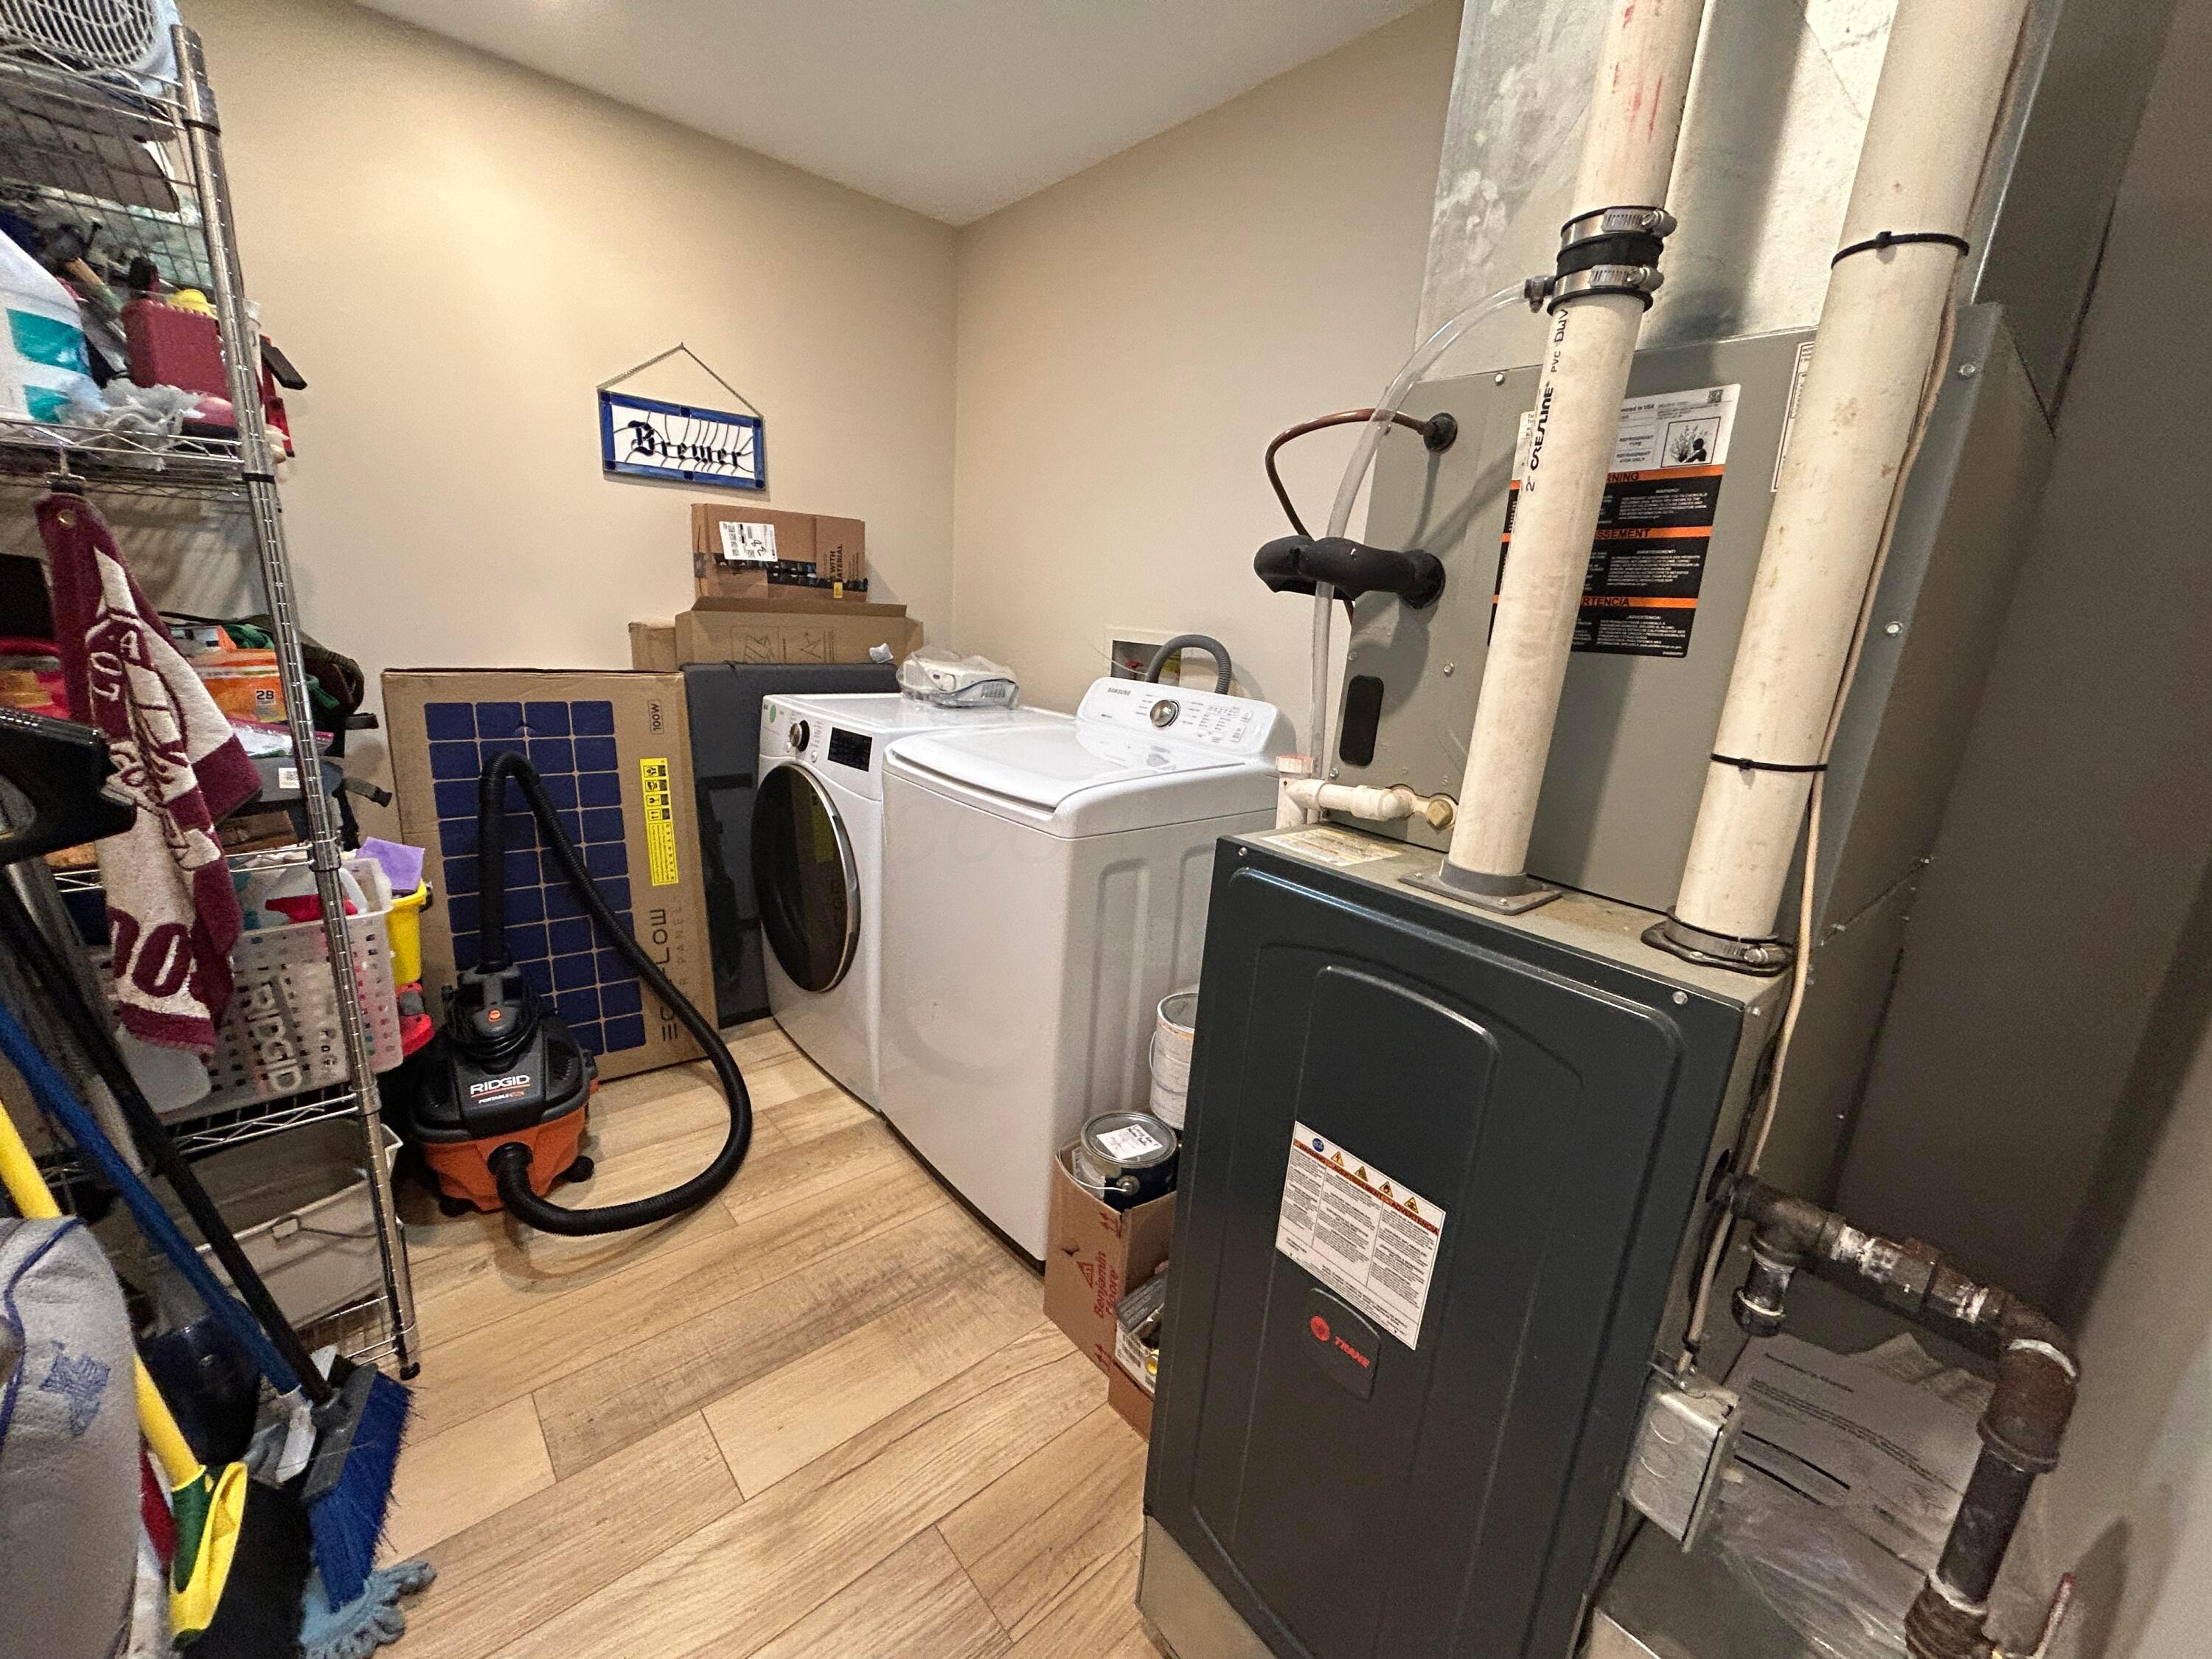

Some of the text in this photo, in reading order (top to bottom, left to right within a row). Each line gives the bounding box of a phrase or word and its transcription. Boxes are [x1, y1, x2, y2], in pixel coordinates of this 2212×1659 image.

[1554, 309, 1568, 343] DWV
[1551, 350, 1561, 372] PVC
[1607, 472, 1639, 482] RNING
[1596, 529, 1651, 539] SSEMENT
[1581, 597, 1630, 607] RTENCIA
[256, 690, 274, 700] 28
[650, 703, 661, 731] 100W
[470, 1074, 531, 1095] RIDGID
[1093, 1251, 1107, 1319] Benjamin
